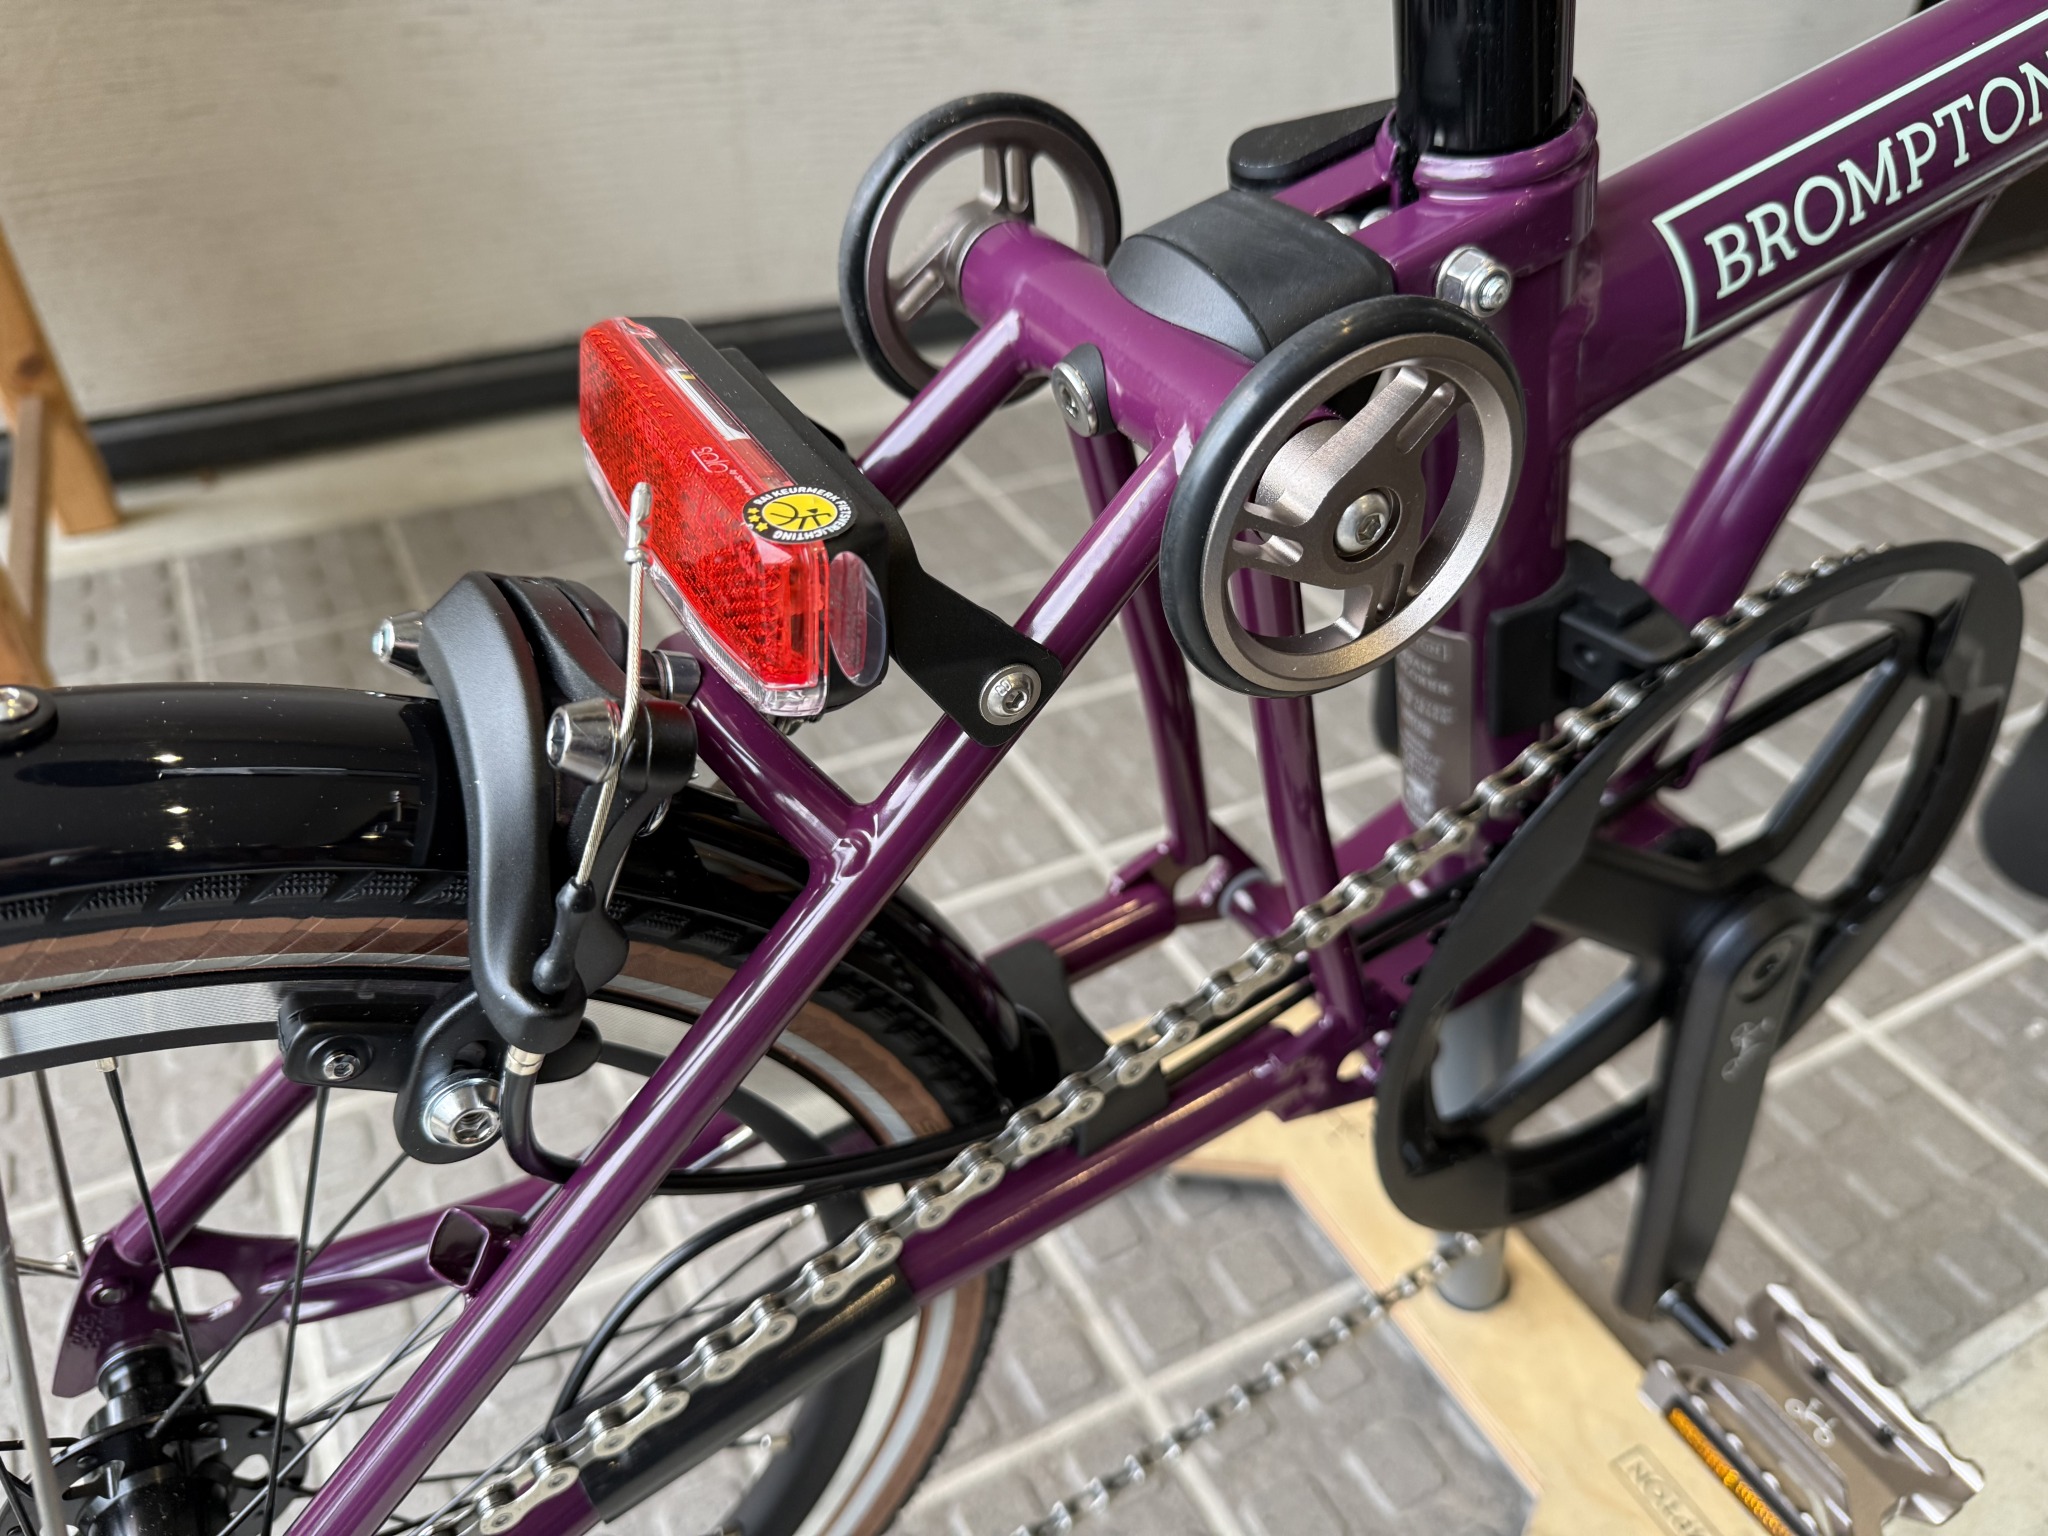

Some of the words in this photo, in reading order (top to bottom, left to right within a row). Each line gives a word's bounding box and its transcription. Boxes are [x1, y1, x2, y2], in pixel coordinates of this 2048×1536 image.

[753, 494, 774, 505] RAI
[772, 486, 840, 502] KEURMERK
[772, 500, 852, 541] FIETSVERLICHTING
